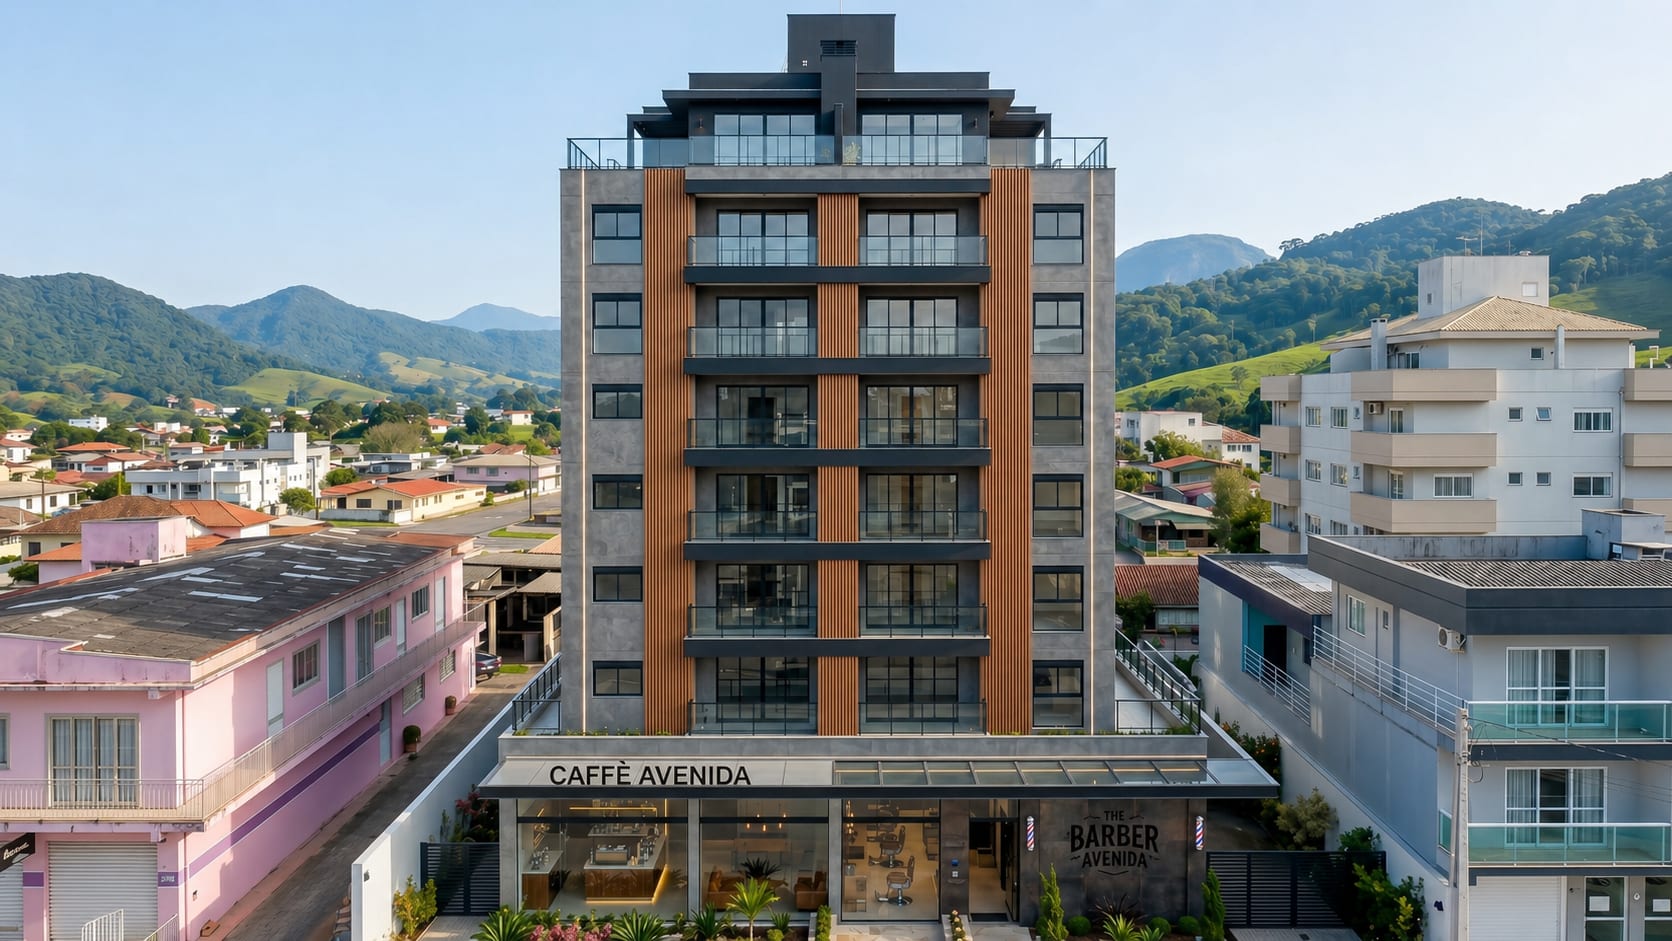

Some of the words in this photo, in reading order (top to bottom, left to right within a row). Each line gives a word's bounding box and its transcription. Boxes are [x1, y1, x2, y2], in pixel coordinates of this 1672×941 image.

[550, 761, 631, 785] CAFFÈ
[639, 766, 751, 785] AVENIDA
[1104, 811, 1124, 820] THE
[1071, 824, 1159, 852] BARBER
[1082, 851, 1147, 868] AVENIDA
